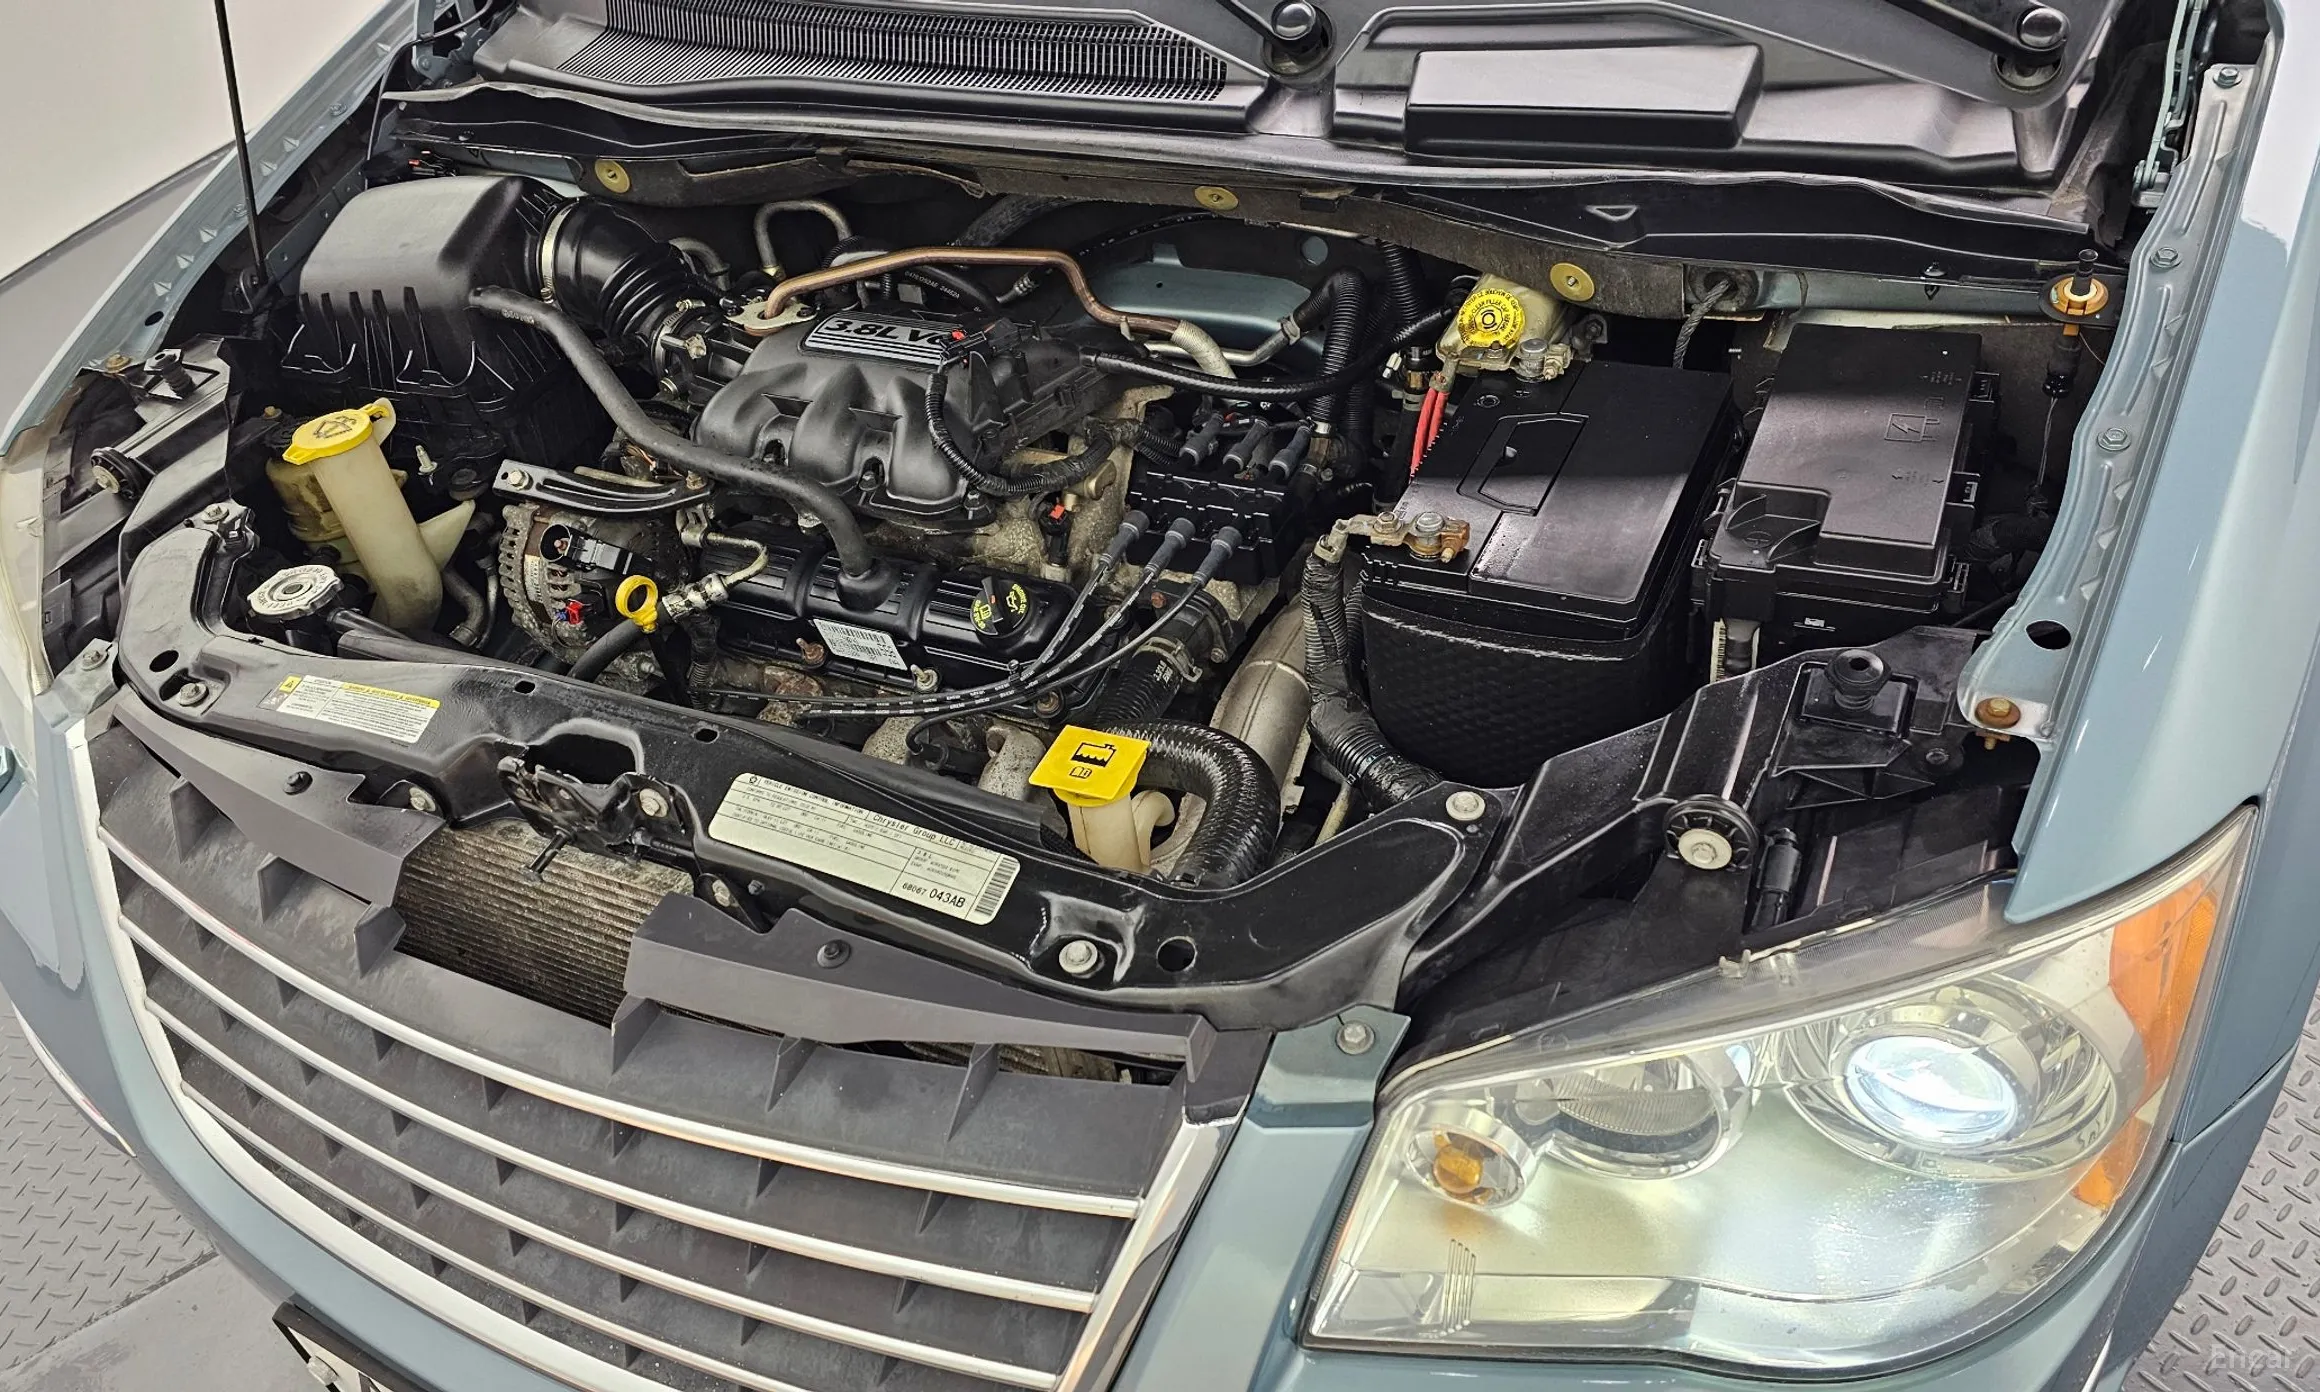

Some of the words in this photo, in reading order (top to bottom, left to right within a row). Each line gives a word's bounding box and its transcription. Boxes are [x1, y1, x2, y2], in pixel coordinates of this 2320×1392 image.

[825, 320, 898, 340] 3.8L
[1017, 603, 1027, 615] OIL
[872, 814, 909, 831] Chrysler
[913, 826, 936, 840] Group
[939, 835, 956, 846] LLC
[929, 888, 966, 908] 043AB
